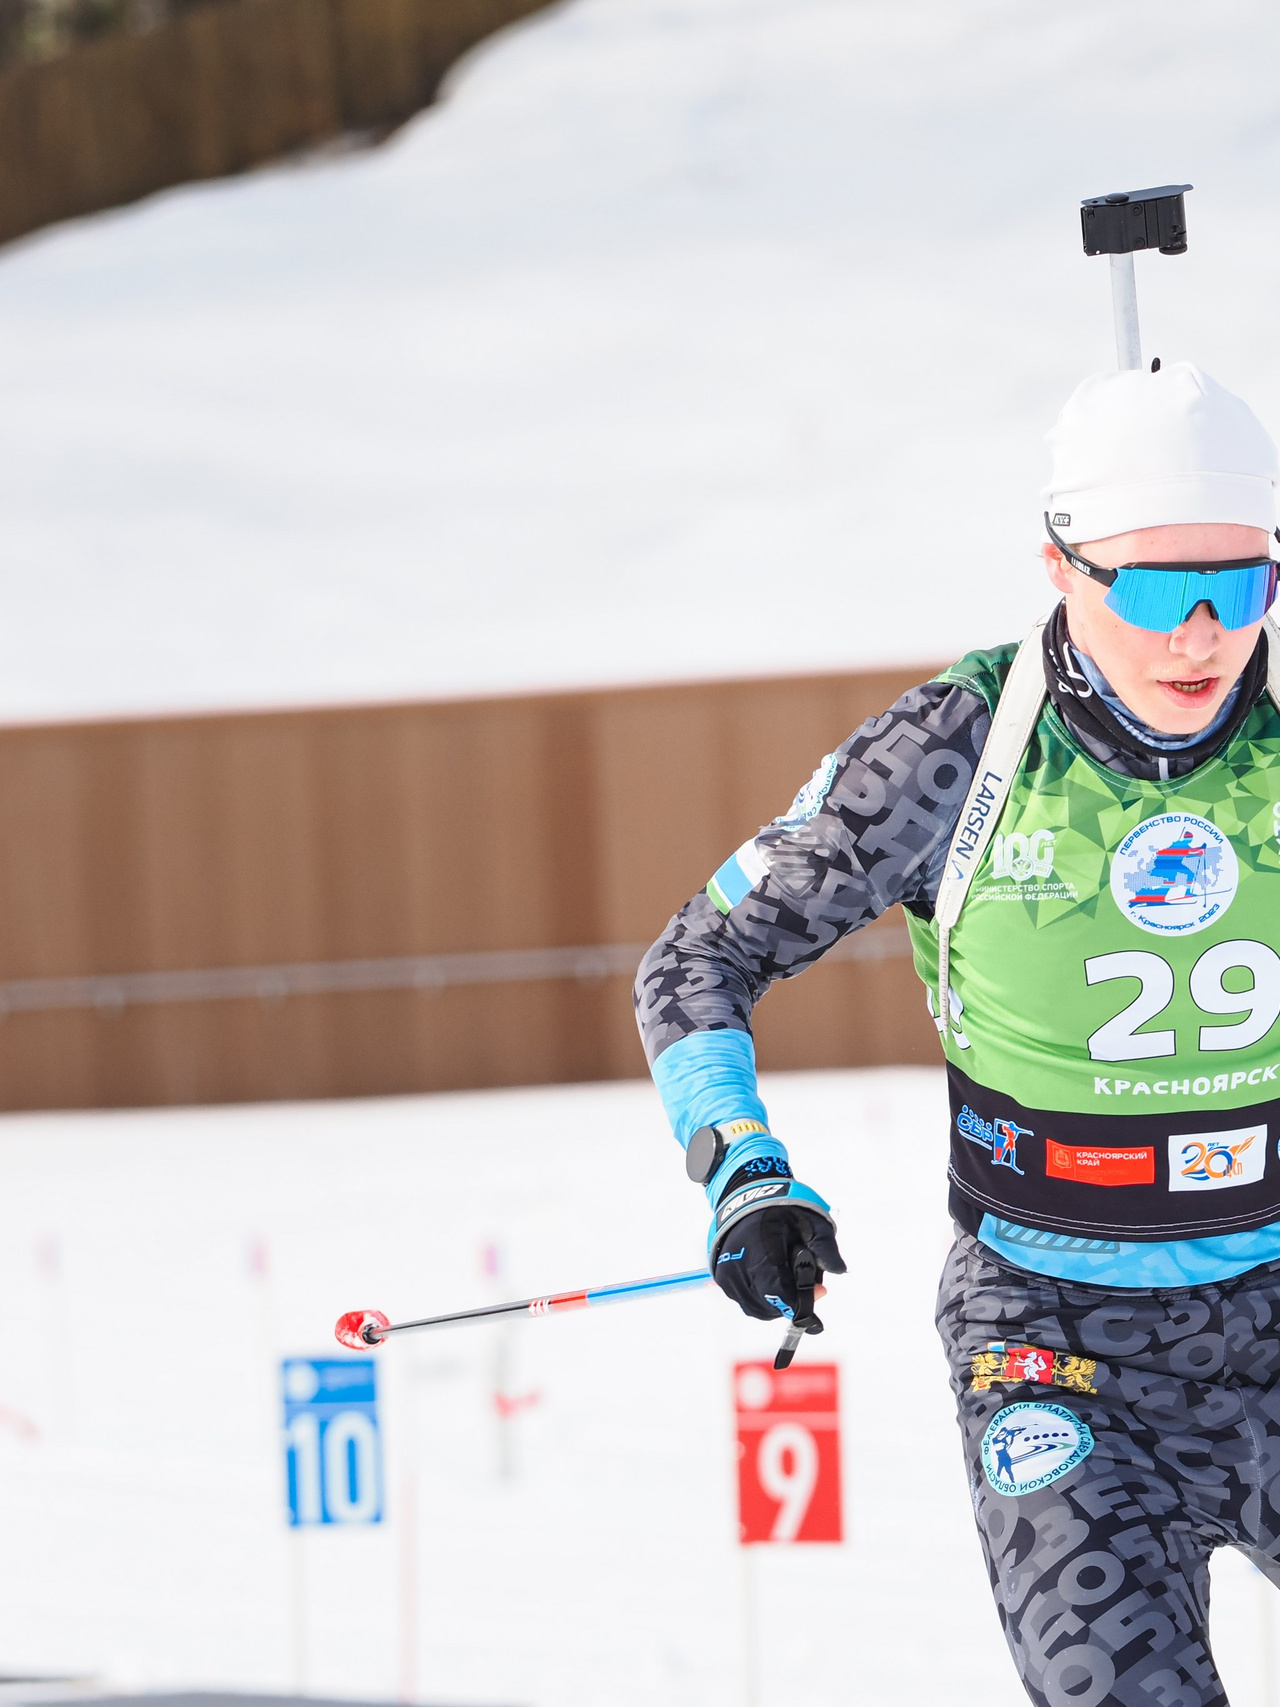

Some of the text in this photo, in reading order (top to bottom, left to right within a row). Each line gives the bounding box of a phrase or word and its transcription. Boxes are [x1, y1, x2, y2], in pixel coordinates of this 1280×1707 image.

[955, 771, 1003, 860] LARSEN
[1119, 815, 1225, 856] ПЕРВЕНСТВО РОССИИ
[975, 882, 1075, 893] МИНИСТЕРСТВО СПОРТА
[1024, 891, 1079, 901] ФЕДЕРАЦИИ
[1137, 915, 1196, 931] Красноярск
[1198, 903, 1220, 923] 2023
[1094, 1063, 1280, 1096] КРАСНОЯРСК
[1076, 1151, 1148, 1160] КРАСНОЯРСКИЙ
[1076, 1158, 1100, 1166] КРАЙ
[285, 1411, 379, 1525] 10
[756, 1421, 821, 1542] 9
